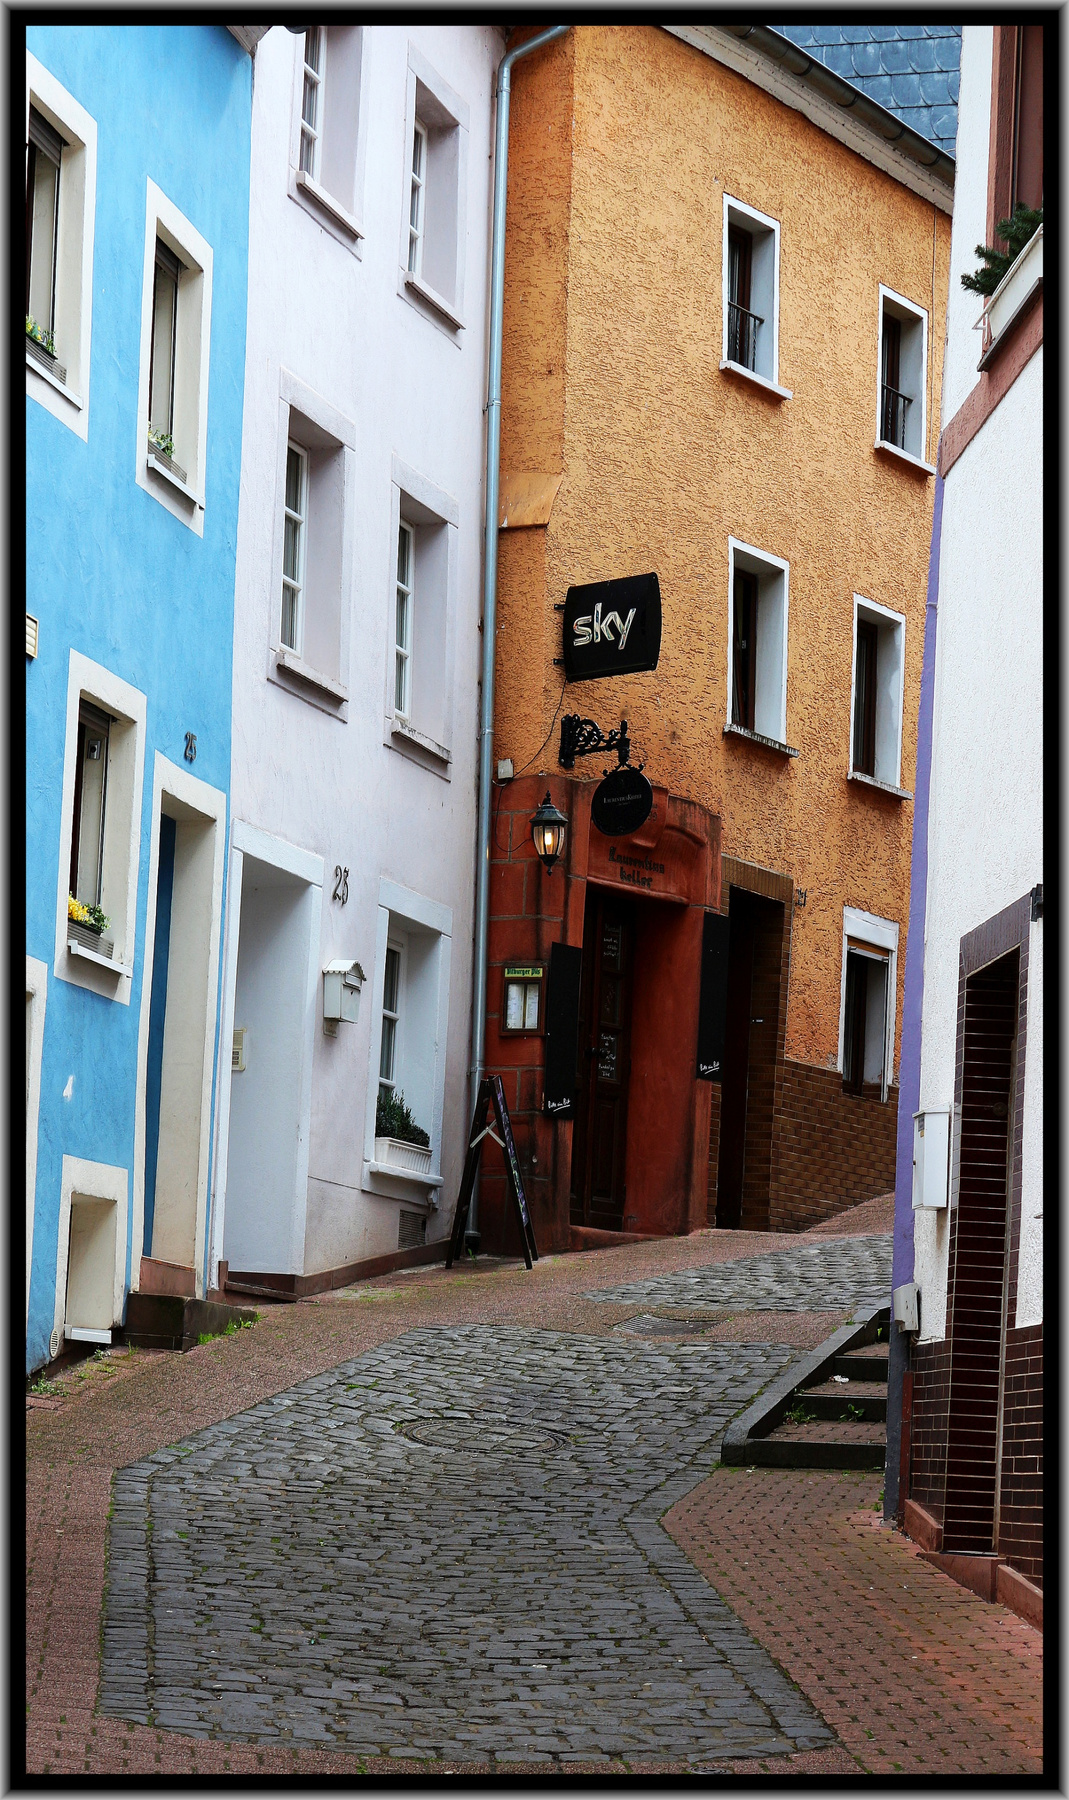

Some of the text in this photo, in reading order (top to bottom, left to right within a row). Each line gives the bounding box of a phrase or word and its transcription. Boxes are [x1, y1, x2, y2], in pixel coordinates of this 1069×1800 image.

[573, 602, 637, 650] sky
[184, 731, 197, 762] 25
[332, 865, 349, 906] 23
